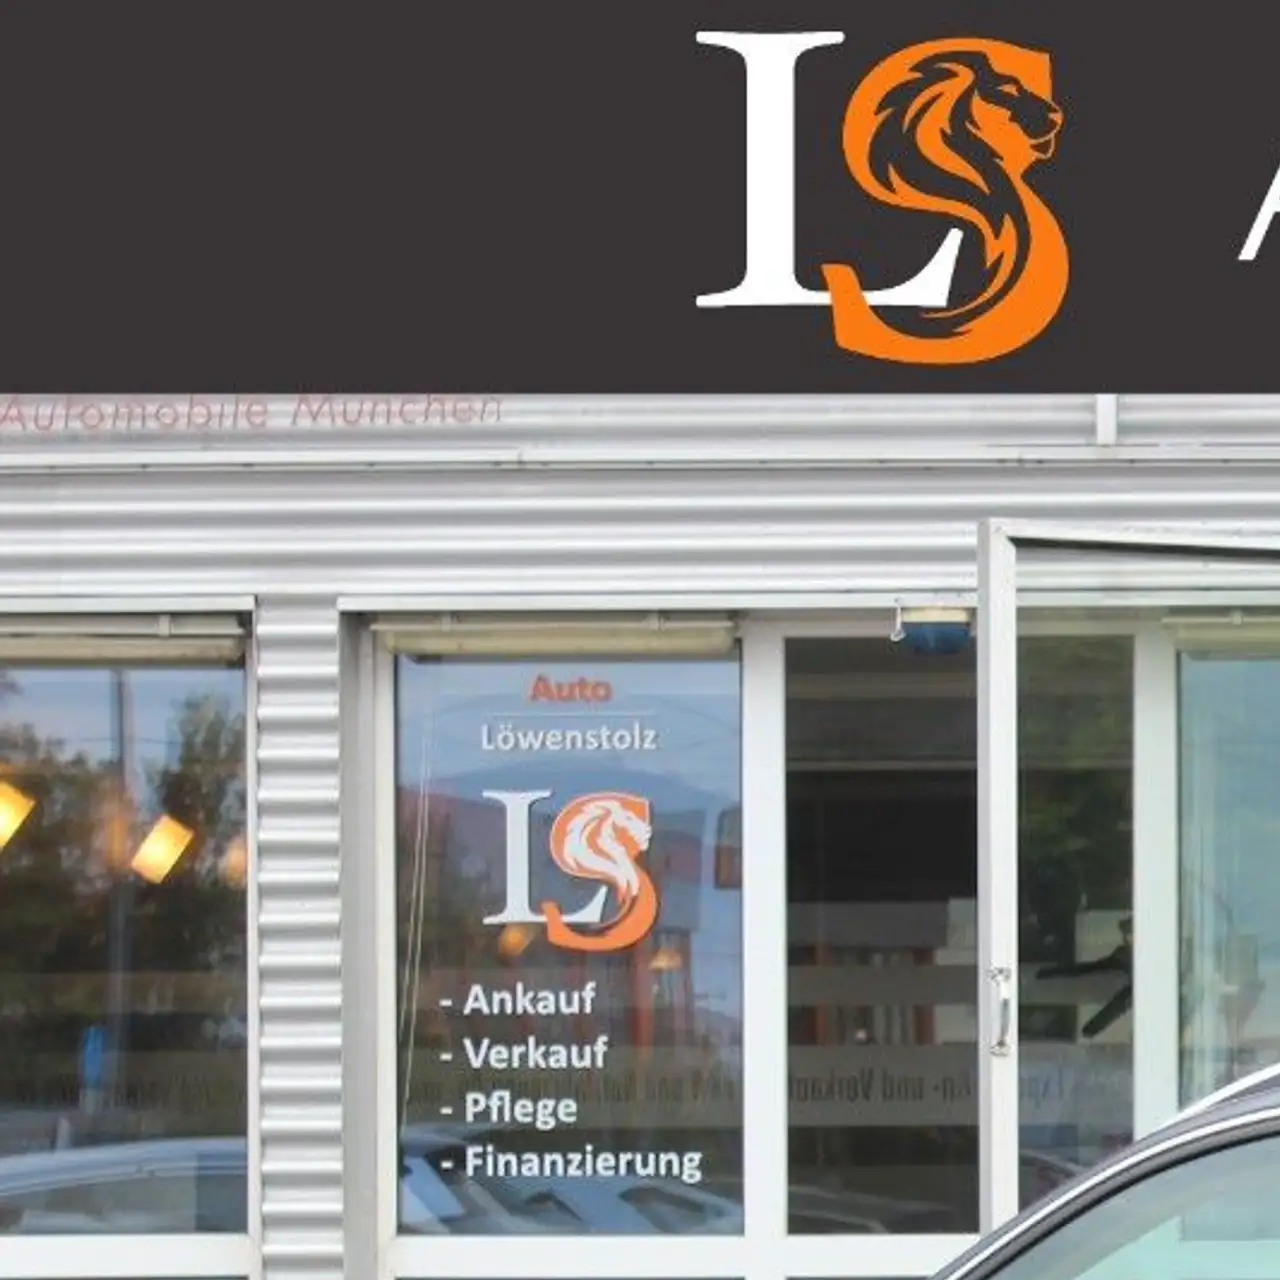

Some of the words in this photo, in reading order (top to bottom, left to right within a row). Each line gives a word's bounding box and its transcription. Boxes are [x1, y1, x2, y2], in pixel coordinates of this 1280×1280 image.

[530, 676, 610, 702] Auto
[481, 721, 658, 752] Löwenstolz
[463, 981, 598, 1016] Ankauf
[463, 1035, 609, 1070] Verkauf
[465, 1090, 578, 1125] Pflege
[466, 1143, 703, 1184] Finanzierung
